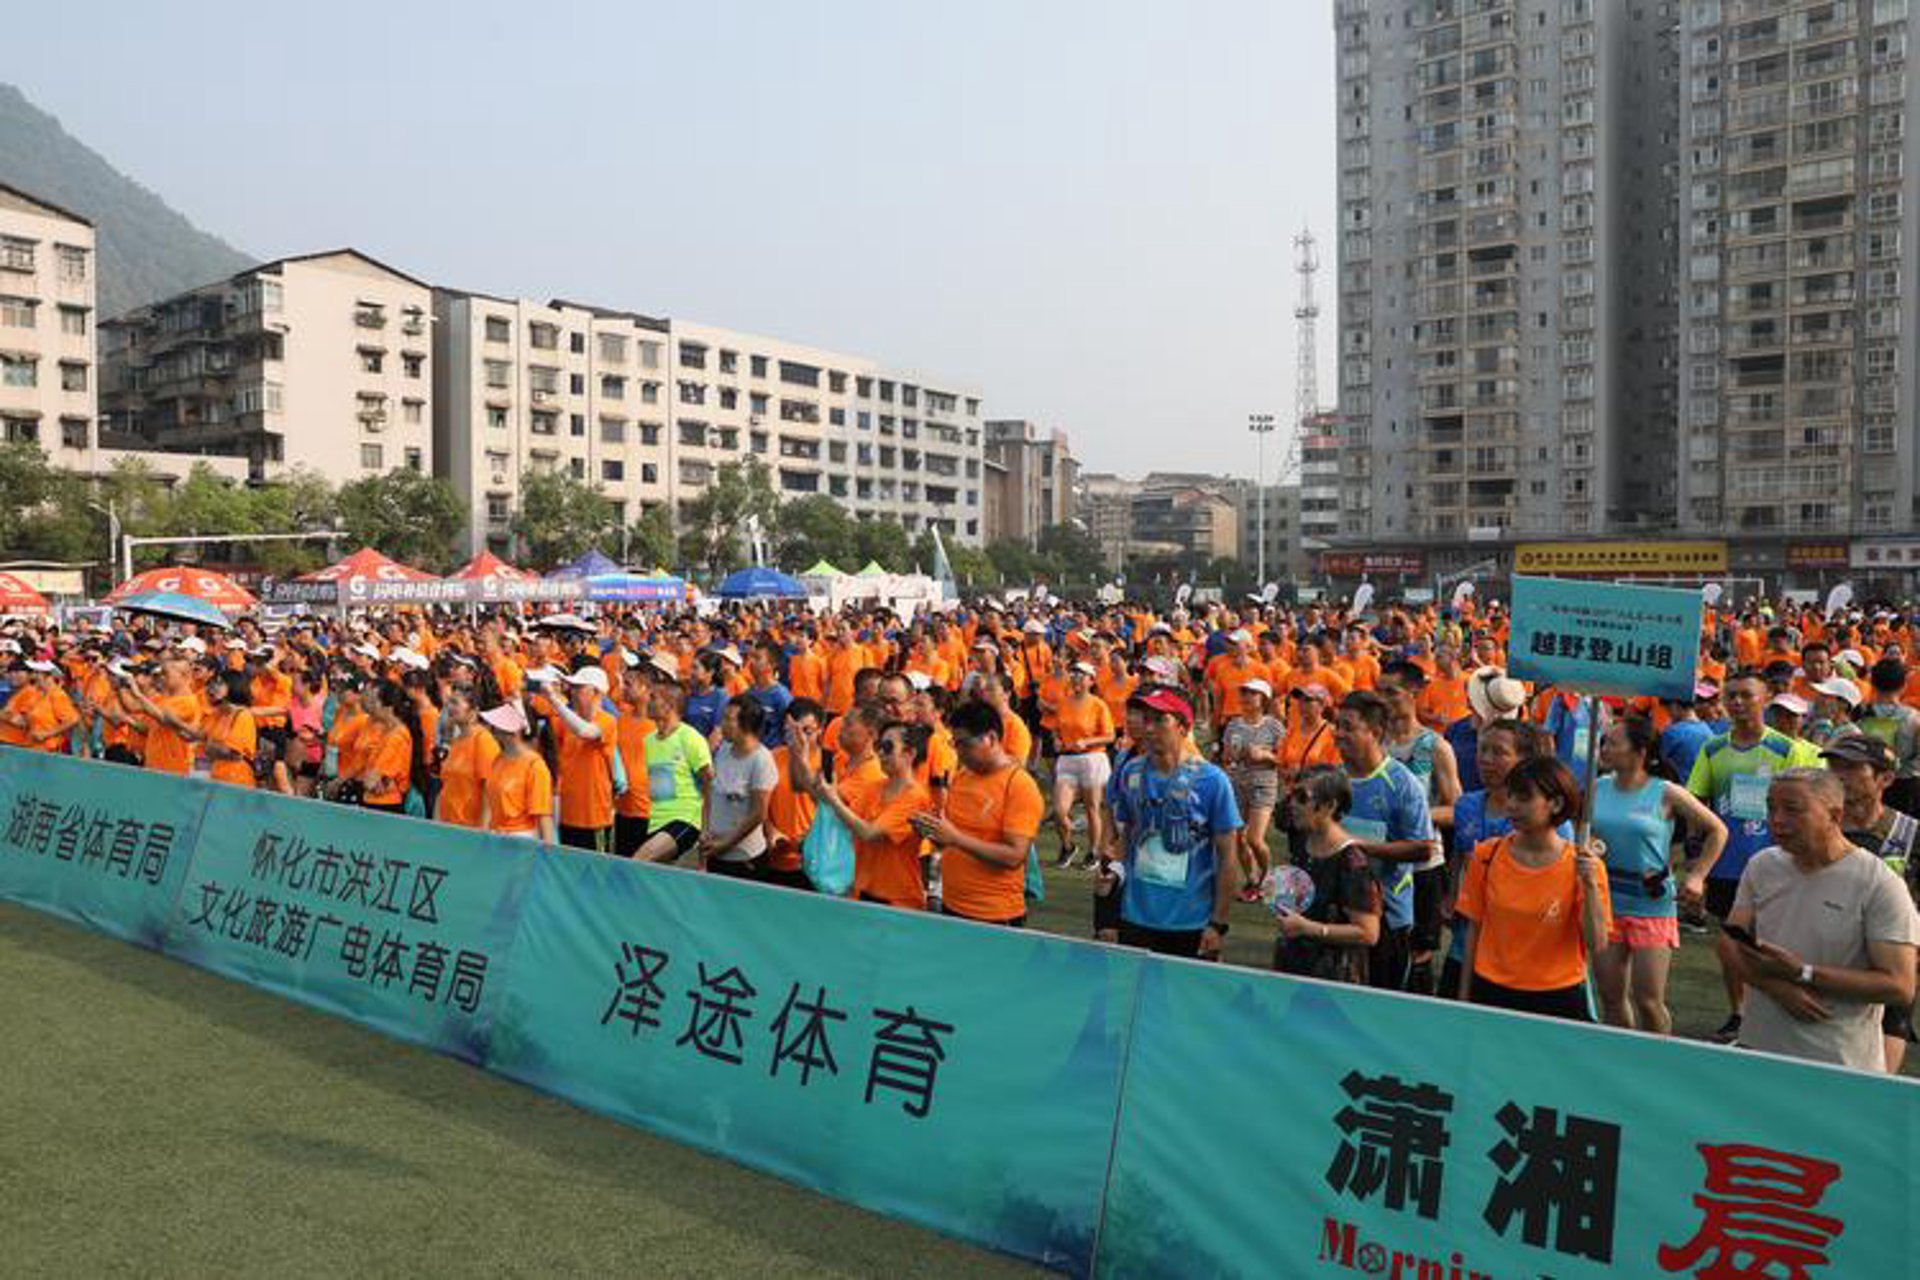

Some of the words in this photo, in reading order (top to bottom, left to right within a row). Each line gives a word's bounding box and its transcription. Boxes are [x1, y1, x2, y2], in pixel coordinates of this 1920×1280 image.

[1531, 631, 1674, 670] 越野登山组
[4, 795, 175, 885] 湖南省体育局
[252, 830, 449, 924] 怀化市洪江区
[190, 882, 489, 1013] 文化旅游广电体育局
[601, 941, 955, 1118] 泽途体育
